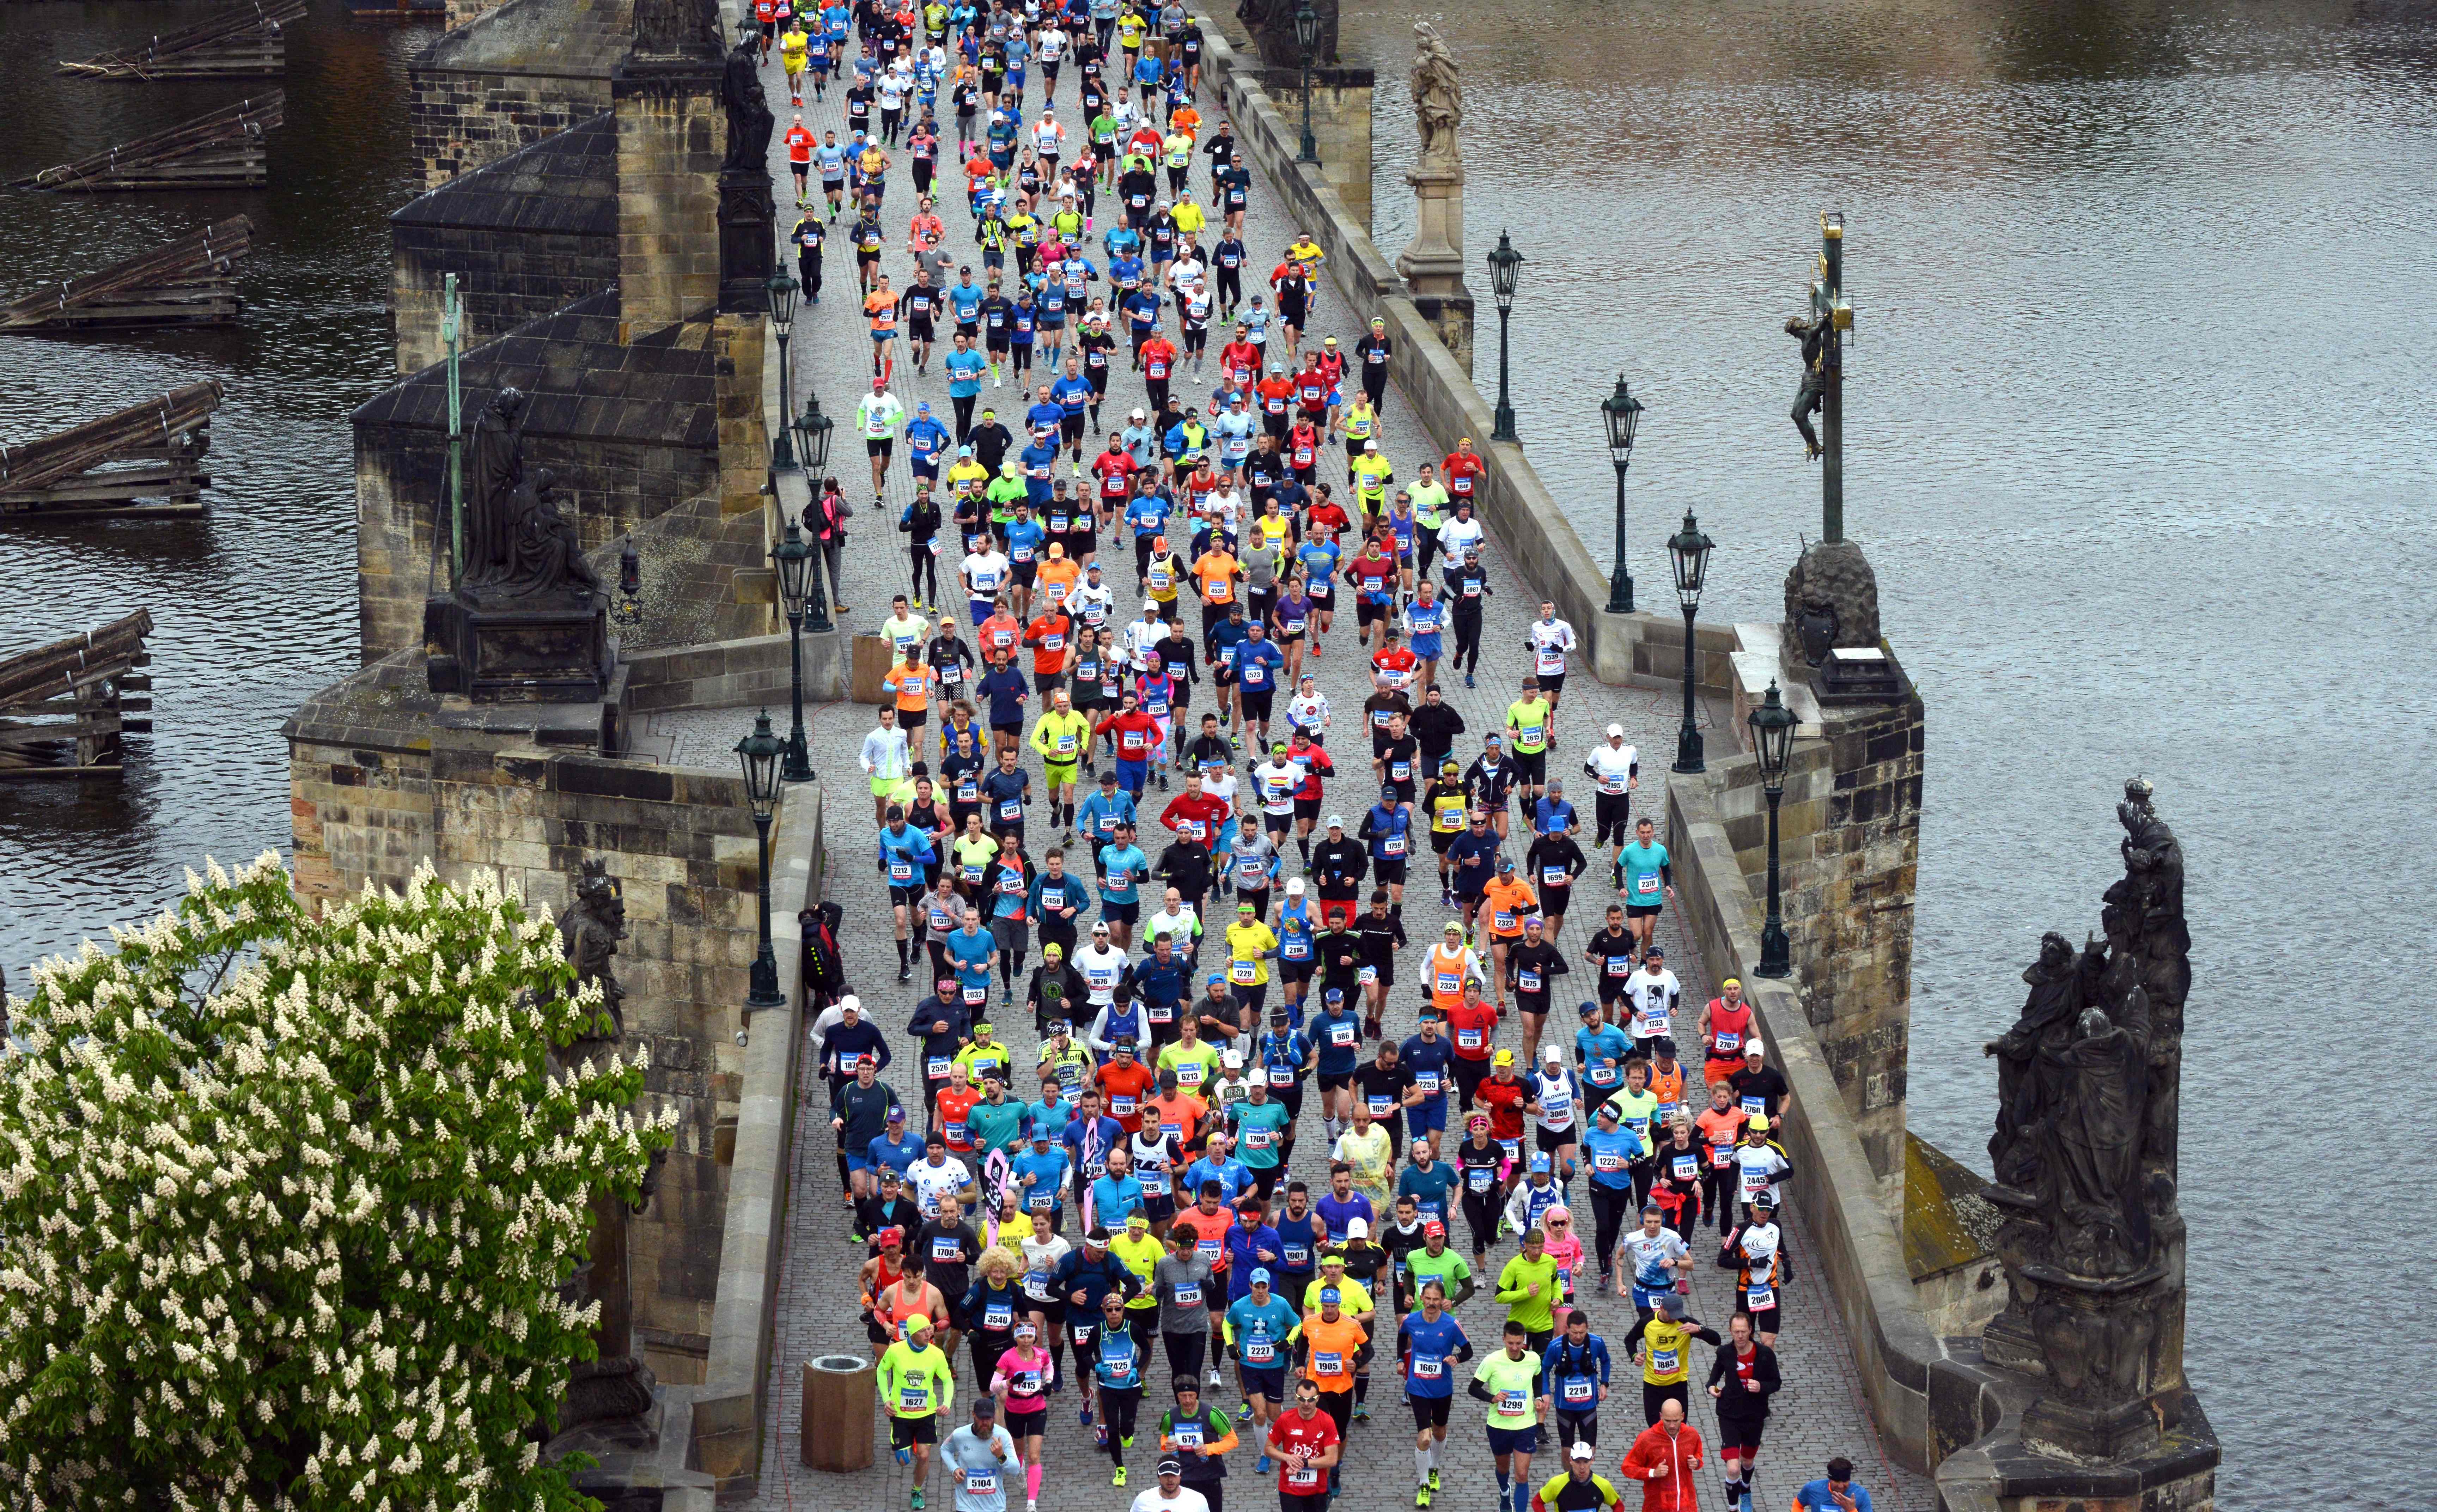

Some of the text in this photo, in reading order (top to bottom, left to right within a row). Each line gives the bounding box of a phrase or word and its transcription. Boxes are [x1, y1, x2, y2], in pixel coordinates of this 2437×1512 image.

[1067, 1093, 1080, 1102] 1655
[1545, 1092, 1570, 1101] SLOVAKIA
[1550, 1109, 1567, 1117] 3006
[1679, 1166, 1694, 1174] F416
[1141, 1184, 1158, 1192] 2495
[1751, 1294, 1770, 1304] 2008
[988, 1315, 1007, 1324] 3540
[1420, 1364, 1437, 1372] 1667
[1657, 1359, 1674, 1368] 1885
[1569, 1386, 1587, 1395] 2218
[1501, 1399, 1522, 1409] 4299
